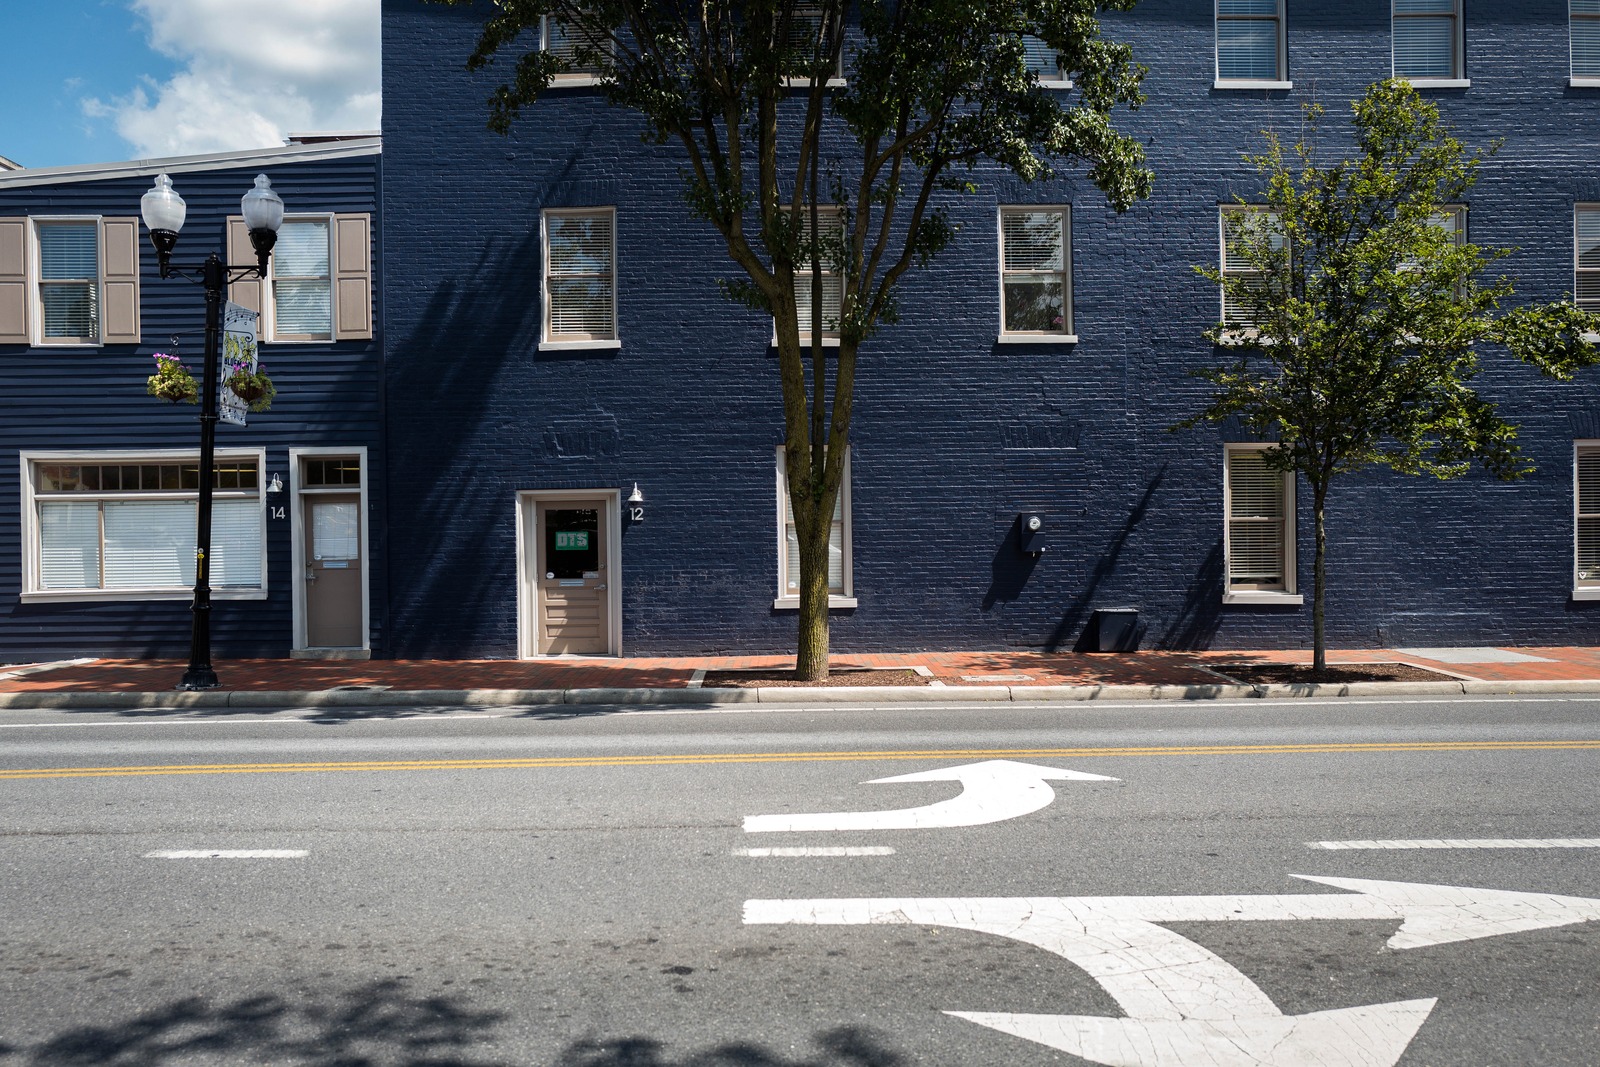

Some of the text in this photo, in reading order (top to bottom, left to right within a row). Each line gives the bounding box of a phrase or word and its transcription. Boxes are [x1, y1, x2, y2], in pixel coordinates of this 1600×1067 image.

[271, 506, 285, 519] 14
[630, 507, 644, 520] 12
[557, 533, 587, 547] DTS
